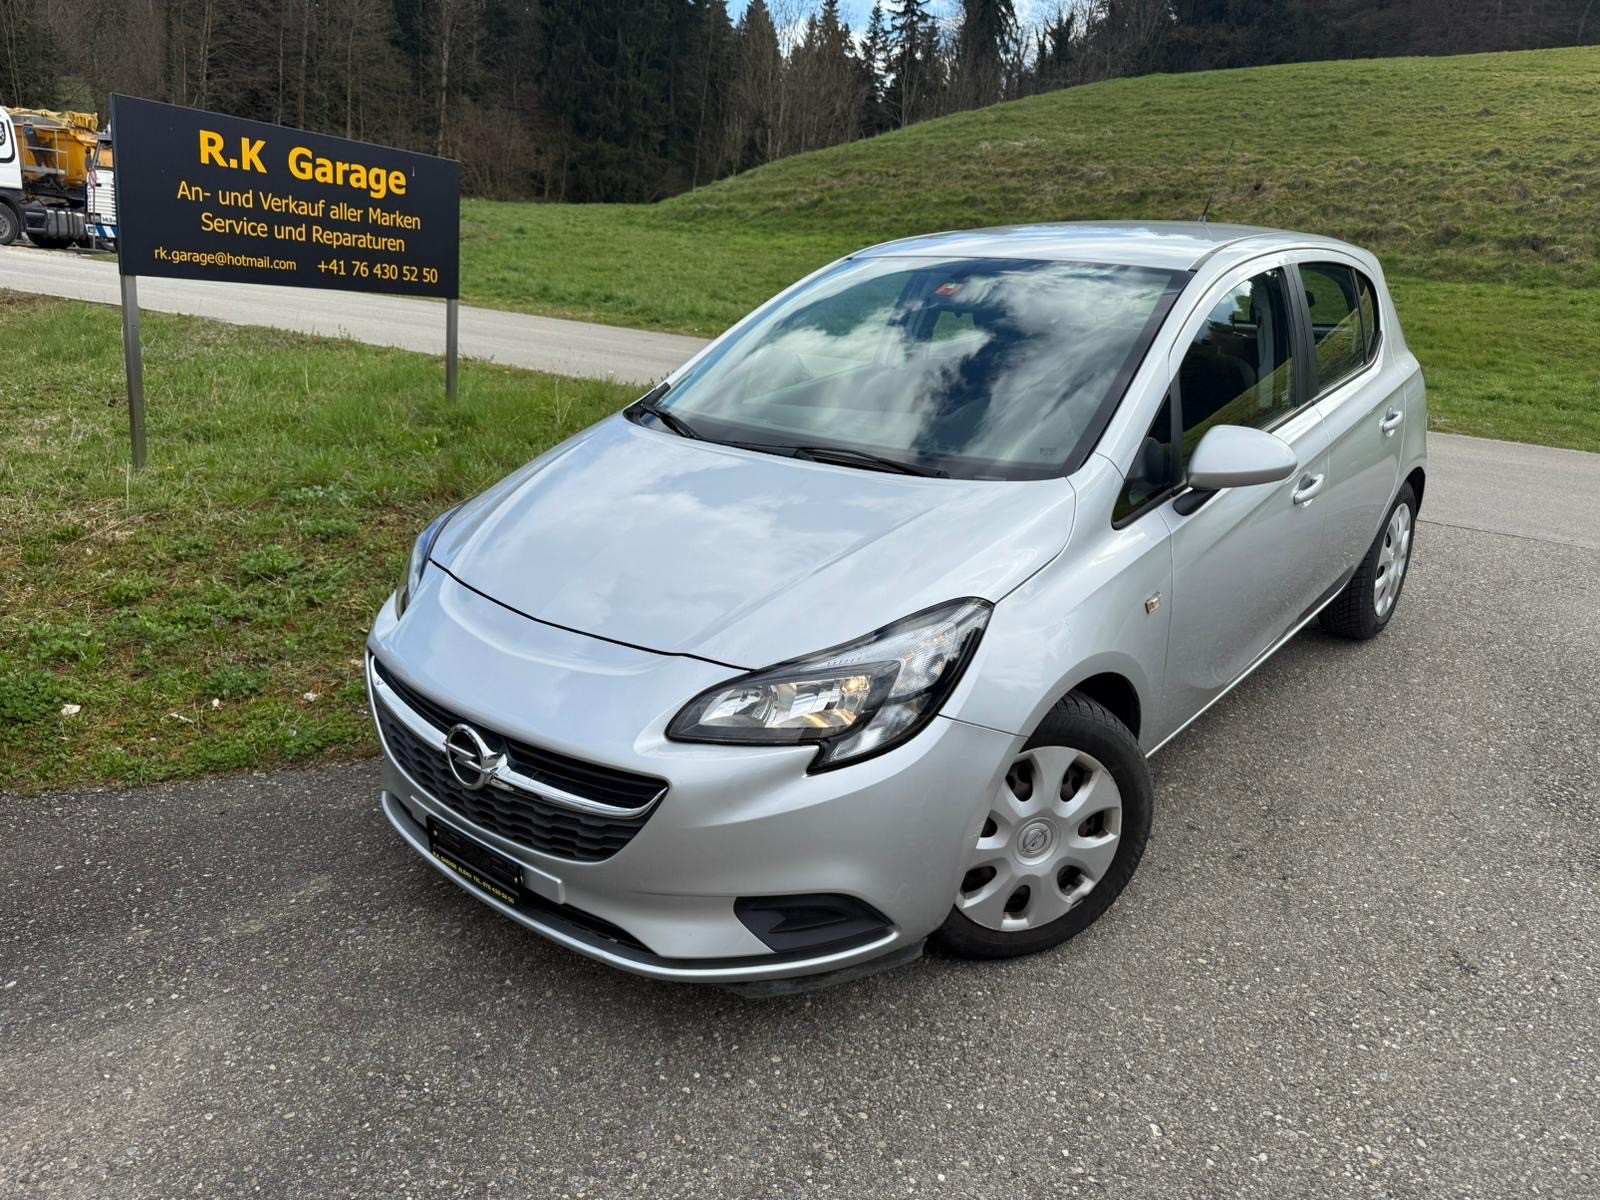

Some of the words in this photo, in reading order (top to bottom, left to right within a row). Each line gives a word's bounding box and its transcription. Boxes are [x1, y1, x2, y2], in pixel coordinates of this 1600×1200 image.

[199, 130, 267, 174] R.K
[288, 146, 406, 199] Garage
[177, 181, 211, 203] An-
[218, 190, 255, 208] und
[260, 193, 325, 217] Verkauf
[330, 204, 363, 223] aller
[368, 208, 421, 229] Marken
[202, 213, 269, 239] Service
[274, 223, 307, 243] und
[312, 225, 406, 252] Reparaturen
[154, 248, 297, 271] rk.garage@hotmail.com
[317, 260, 347, 276] +41
[352, 262, 369, 278] 76
[373, 264, 399, 281] 430
[403, 266, 418, 282] 52
[423, 268, 439, 284] 50
